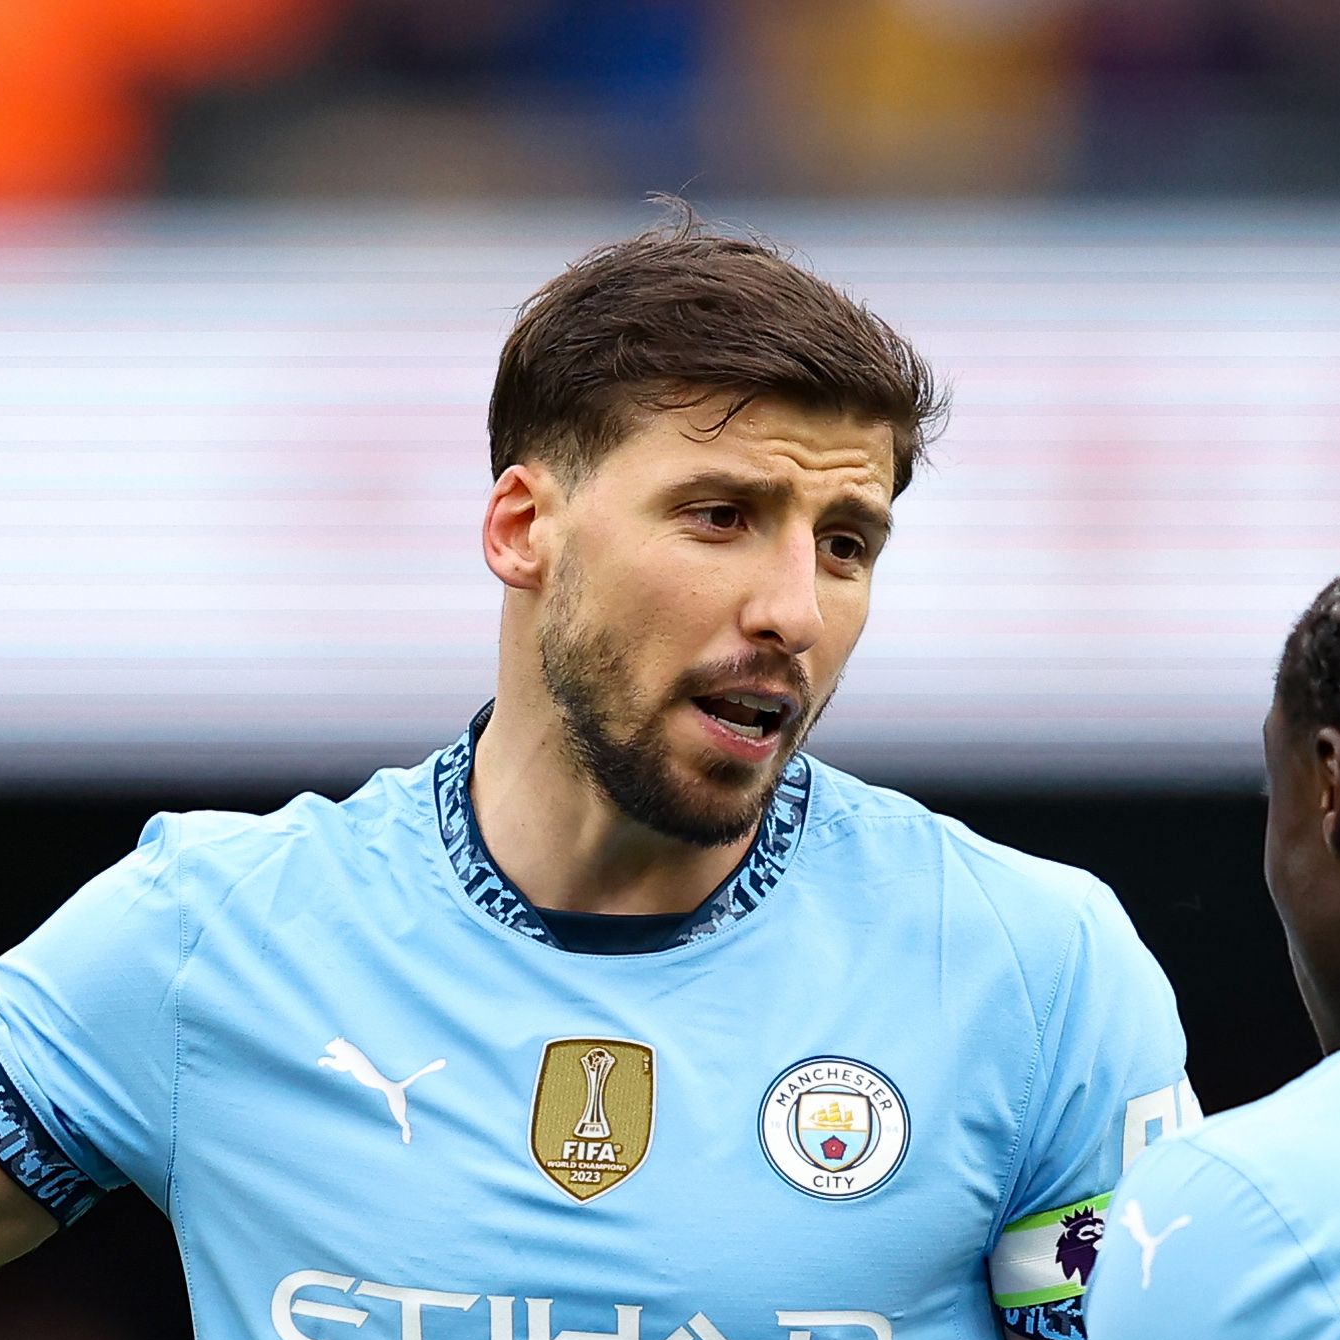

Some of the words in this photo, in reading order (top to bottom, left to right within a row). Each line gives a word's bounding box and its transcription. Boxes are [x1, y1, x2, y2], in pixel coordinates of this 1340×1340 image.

[776, 1068, 893, 1111] MANCHESTER
[547, 1161, 576, 1169] WORLD
[578, 1162, 627, 1171] CHAMPIONS
[570, 1171, 601, 1182] 2023
[813, 1175, 855, 1189] CITY
